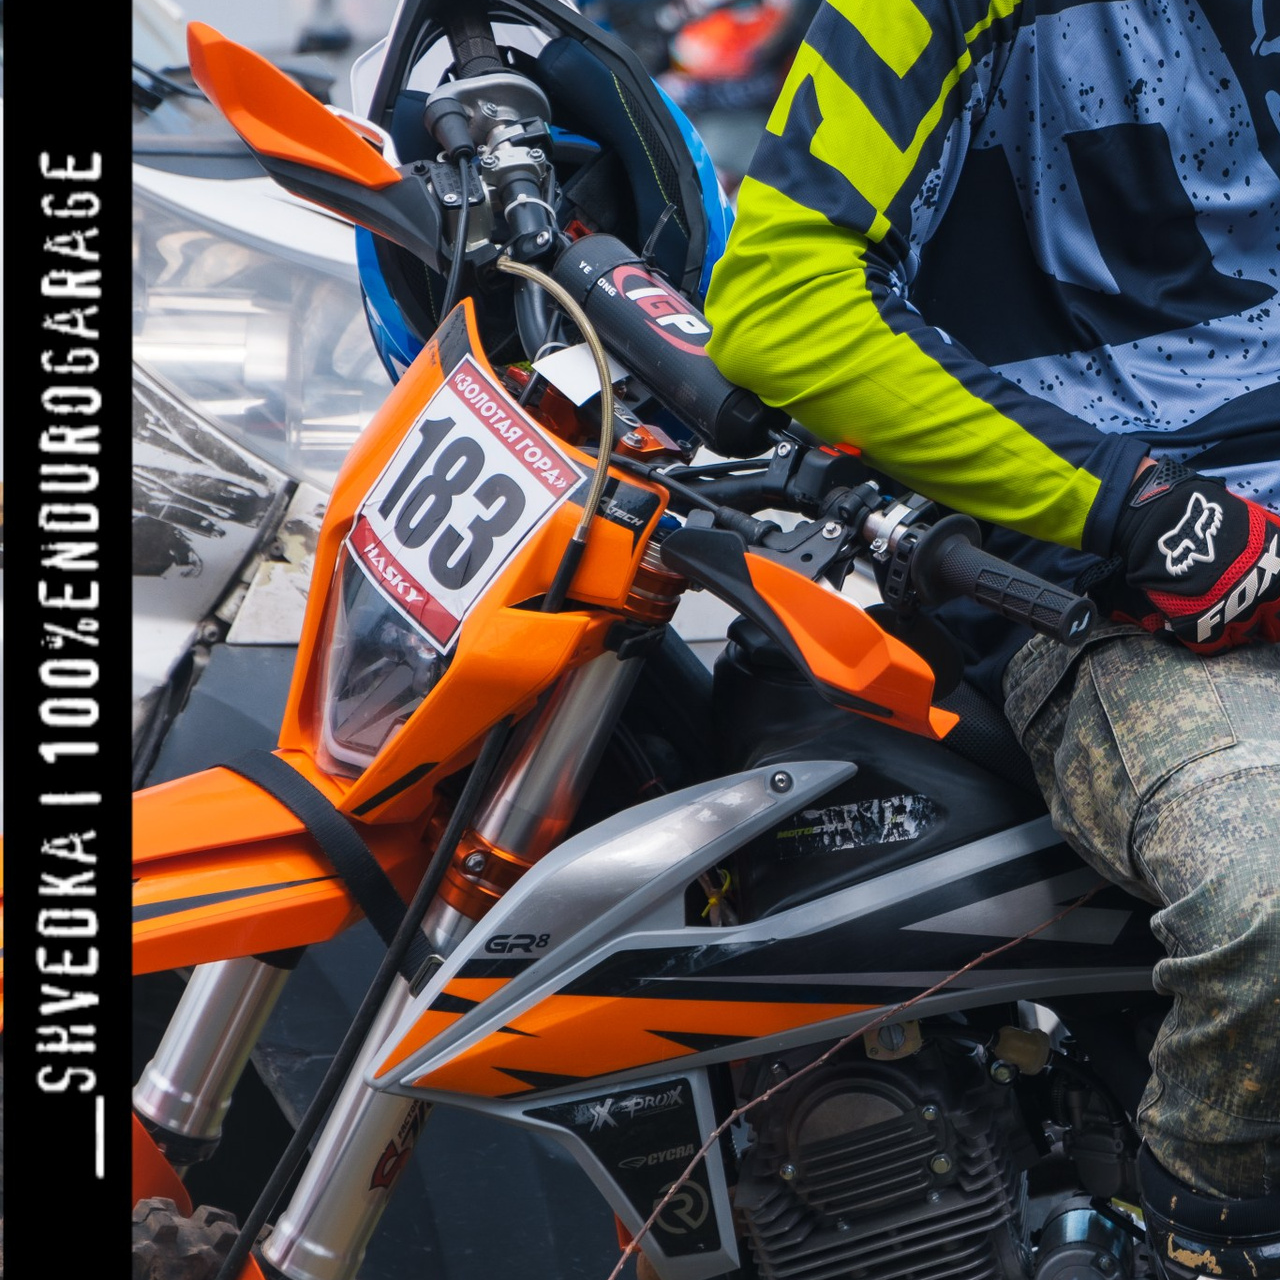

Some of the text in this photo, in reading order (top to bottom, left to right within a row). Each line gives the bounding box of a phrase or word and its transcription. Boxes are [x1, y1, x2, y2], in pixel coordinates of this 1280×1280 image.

[515, 432, 567, 491] ГОРА»
[377, 416, 527, 591] 183
[363, 542, 425, 604] HASKY
[485, 933, 551, 954] GR8
[647, 1143, 695, 1166] CYCRA
